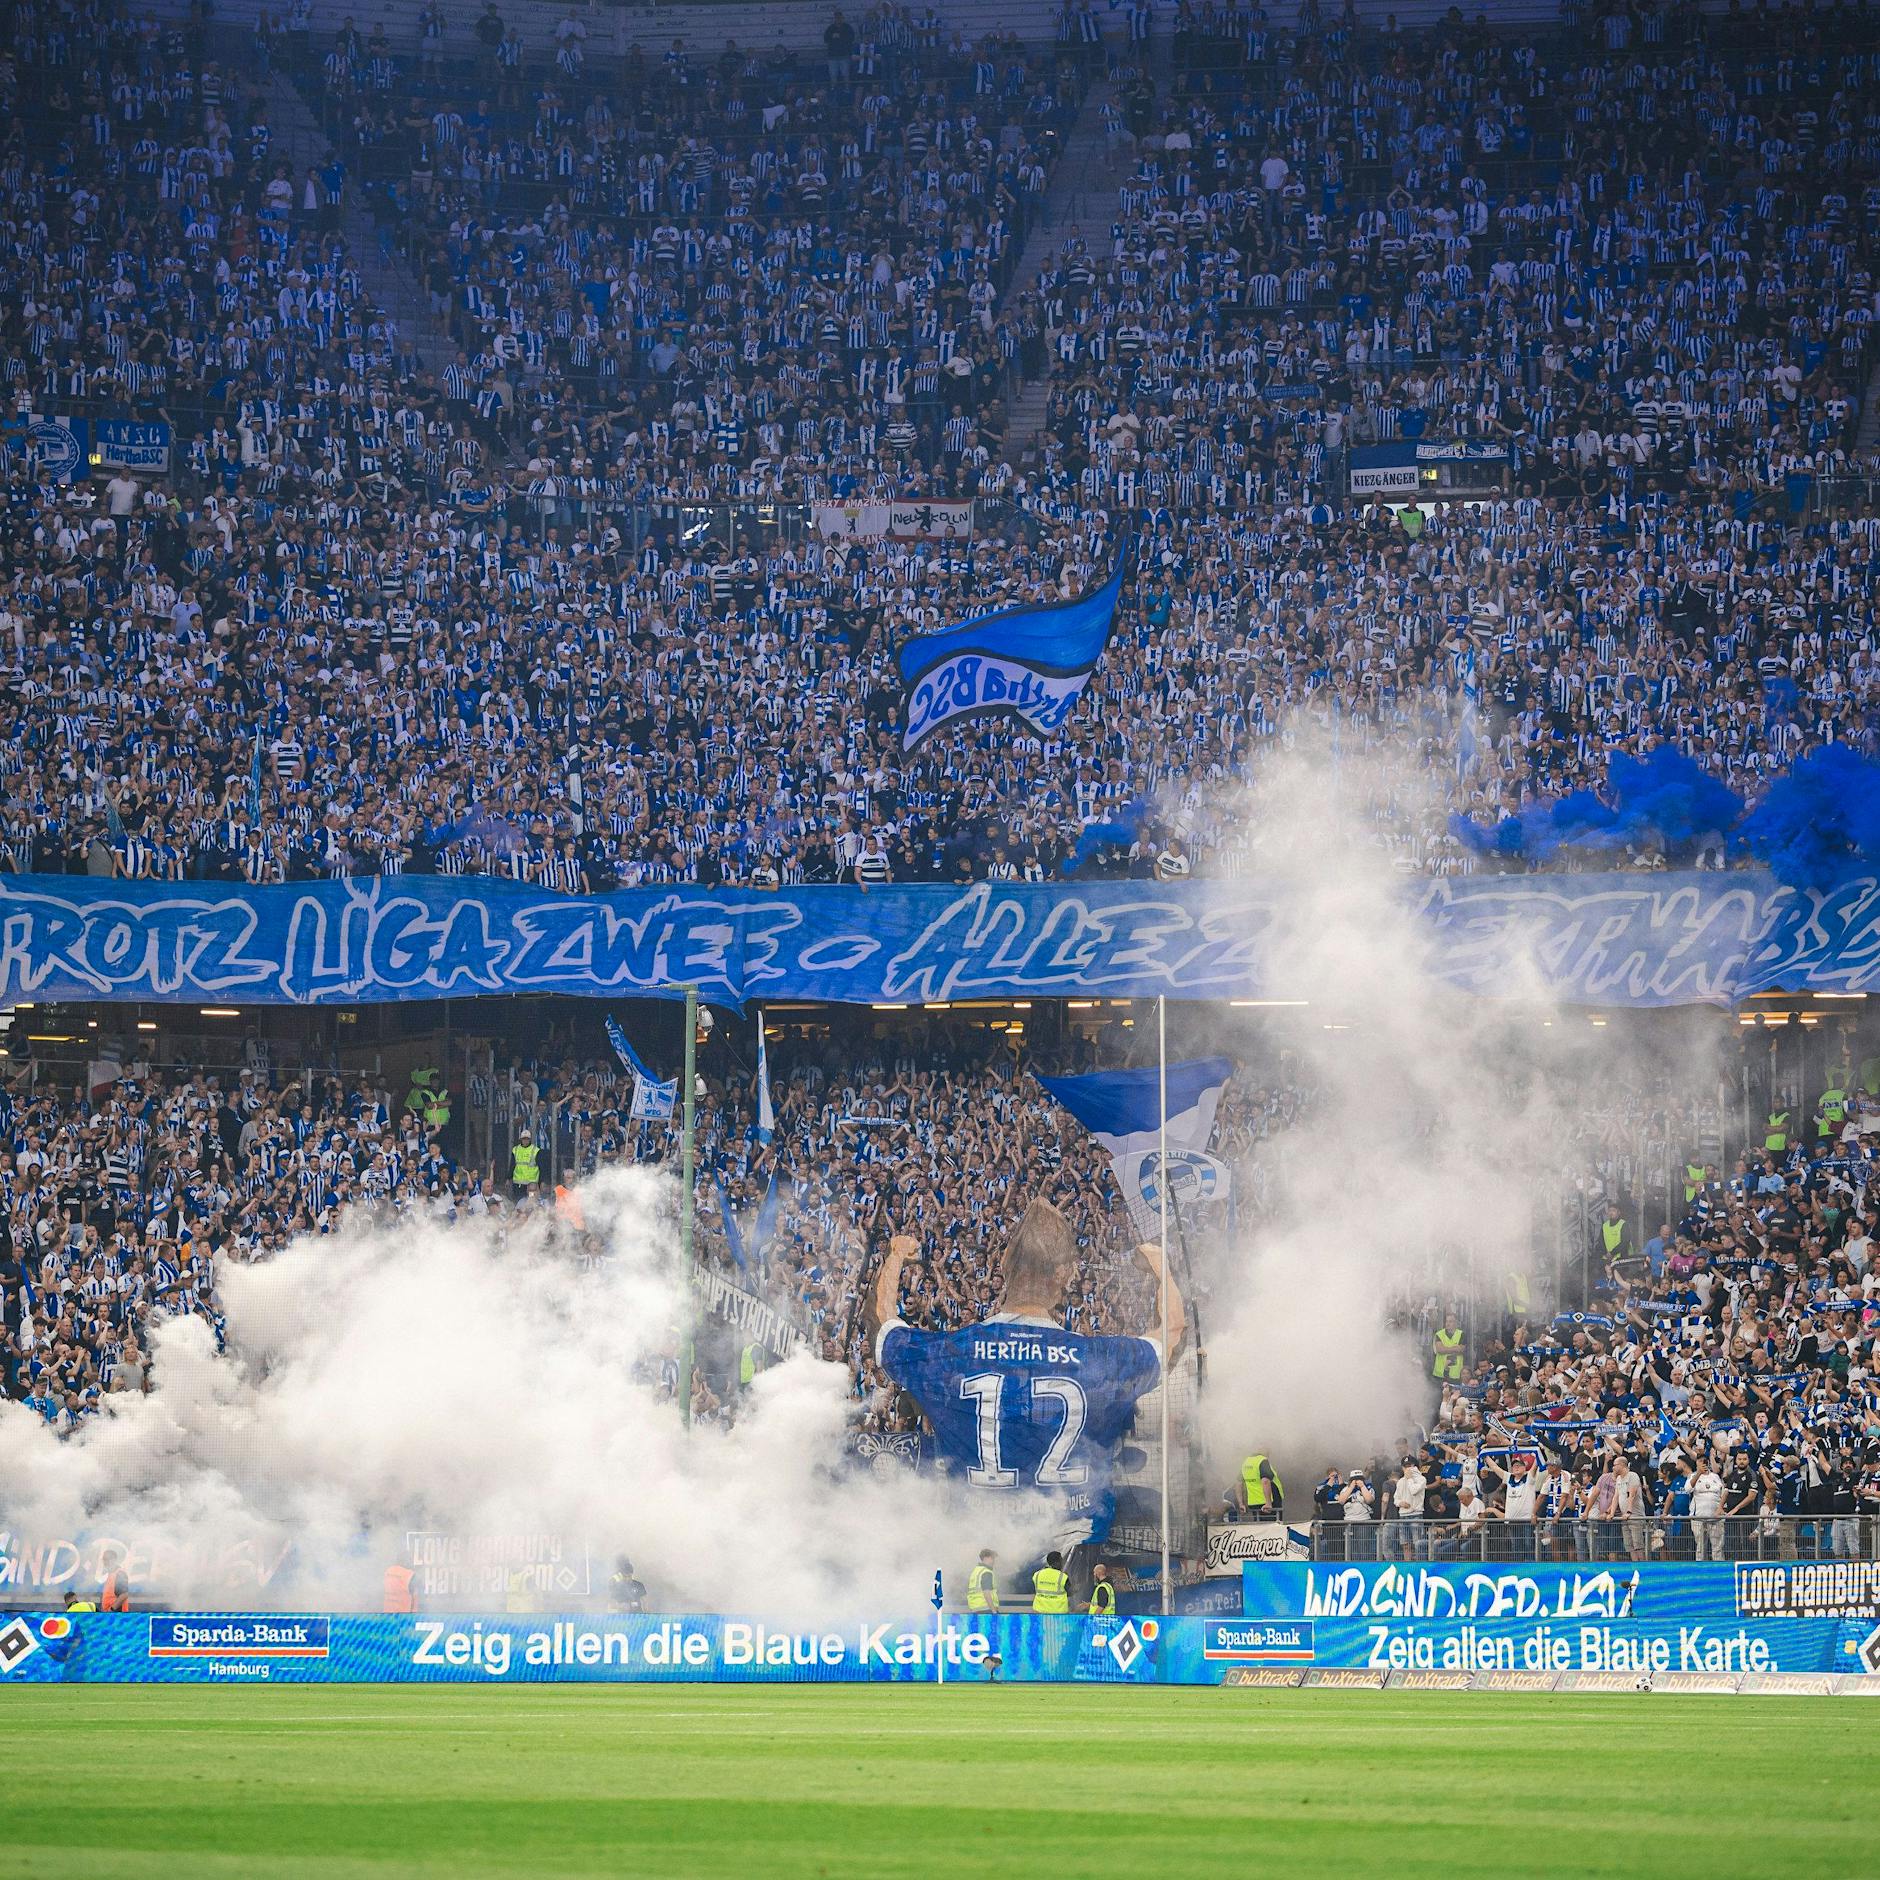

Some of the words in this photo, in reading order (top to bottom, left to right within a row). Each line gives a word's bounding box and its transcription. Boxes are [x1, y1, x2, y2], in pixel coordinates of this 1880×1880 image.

[1353, 472, 1415, 487] KIEZGÄNGER
[814, 499, 839, 508] SEXY
[844, 497, 887, 508] AMAZING
[973, 1340, 1042, 1362] HERTHA
[1046, 1346, 1081, 1364] BSC
[960, 1372, 1089, 1489] 12
[172, 1624, 308, 1646] Sparda-Bank
[1217, 1627, 1301, 1649] Sparda-Bank
[412, 1622, 511, 1675] Zeig
[524, 1622, 629, 1665] allen
[642, 1623, 709, 1665] die
[723, 1623, 846, 1666] Blaue
[1368, 1625, 1434, 1670] Zeig
[1443, 1625, 1515, 1670] allen
[1523, 1626, 1571, 1671] die
[1580, 1626, 1670, 1671] Blaue
[1679, 1626, 1778, 1672] Karte.
[208, 1662, 270, 1678] Hamburg
